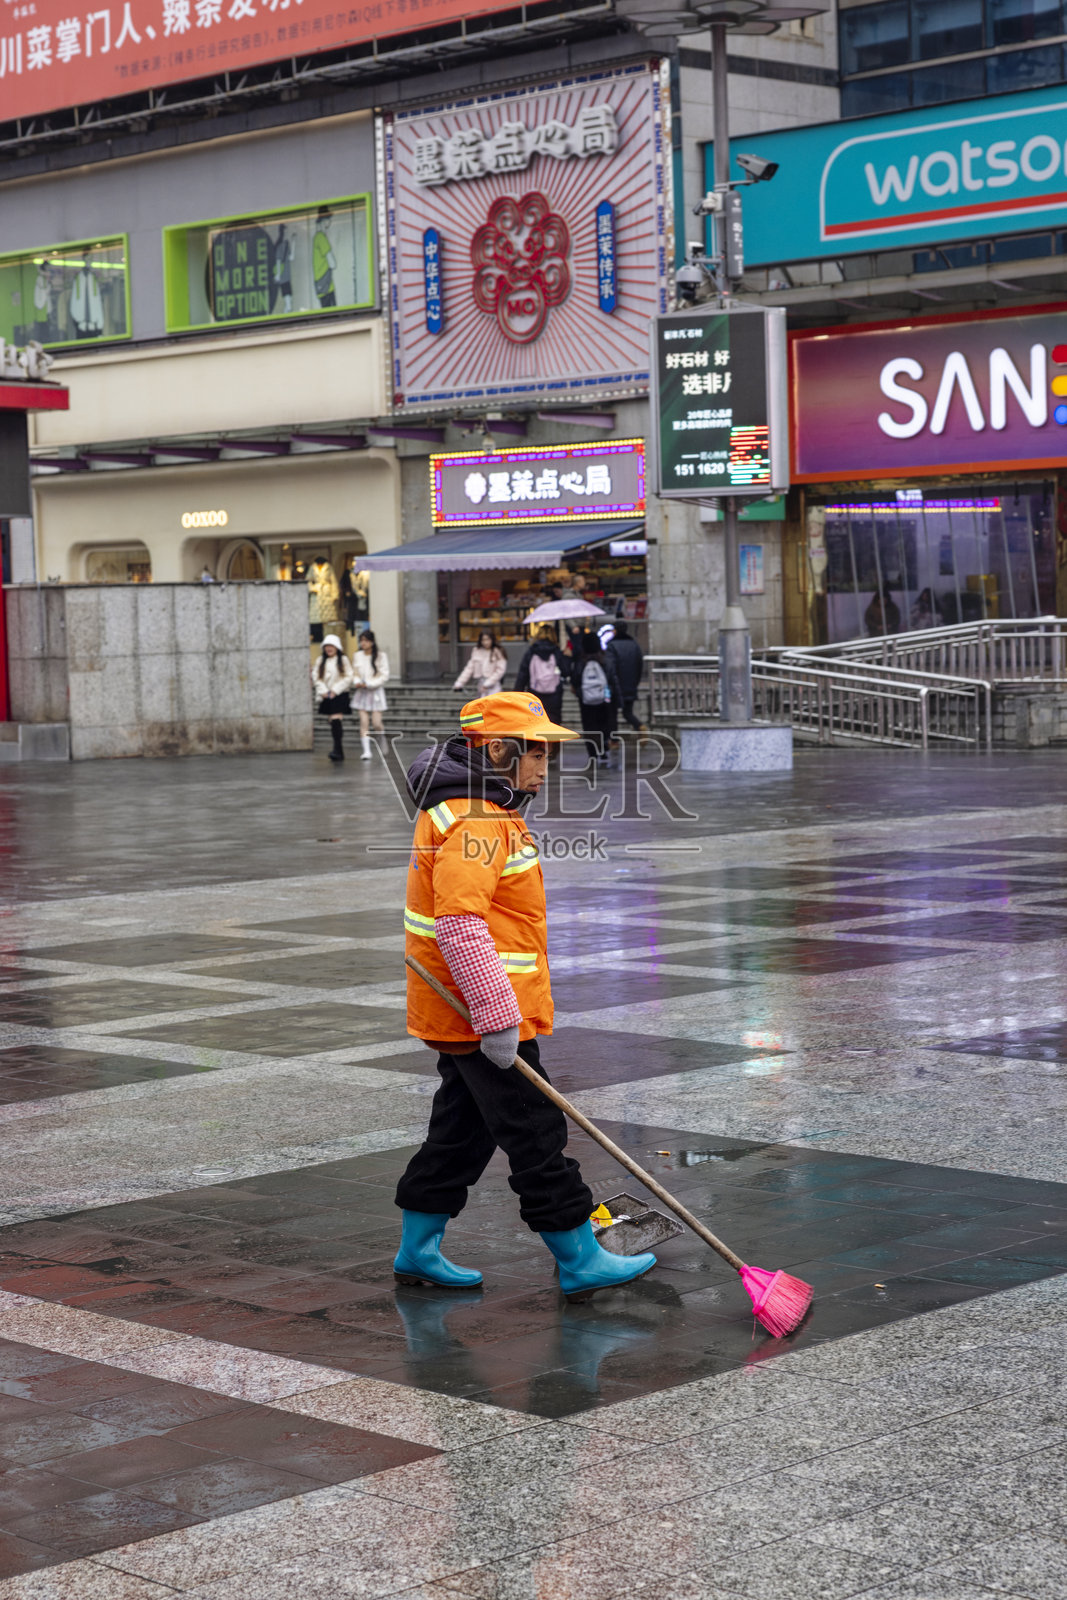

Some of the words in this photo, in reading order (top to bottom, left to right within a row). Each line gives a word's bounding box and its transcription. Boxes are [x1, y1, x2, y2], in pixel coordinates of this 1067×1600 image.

[0, 0, 304, 78] 川菜掌门人、辣条
[864, 134, 1067, 206] watso
[214, 238, 267, 267] ONE
[598, 213, 615, 300] 墨茉传承
[215, 264, 268, 292] MORE
[425, 241, 441, 320] 中华点心
[216, 289, 269, 318] OPTION
[507, 297, 537, 318] MO
[665, 351, 709, 369] 好石材
[713, 350, 730, 366] 好
[489, 464, 611, 503] 墨茉点心局
[674, 463, 695, 476] 151
[697, 462, 726, 475] 1620
